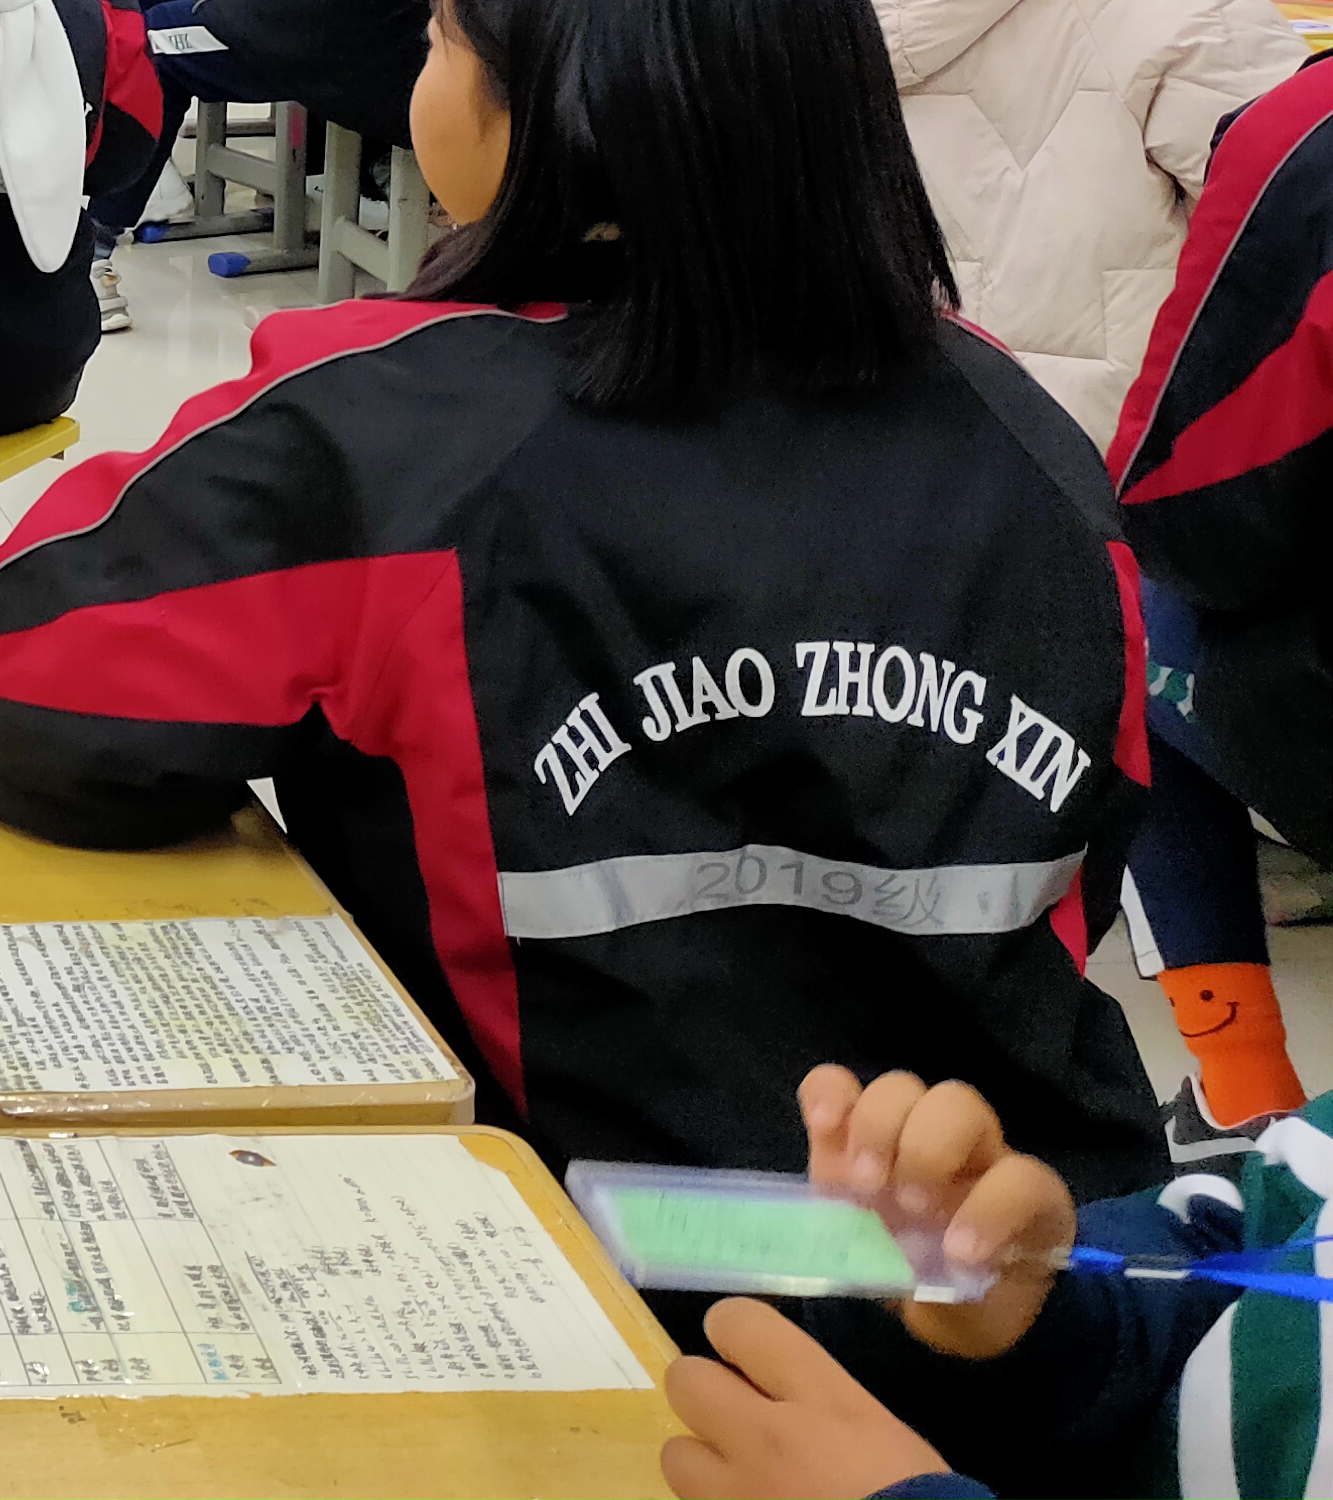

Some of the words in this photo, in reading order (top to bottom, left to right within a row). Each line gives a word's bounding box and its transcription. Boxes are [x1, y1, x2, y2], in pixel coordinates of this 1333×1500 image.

[534, 692, 632, 817] ZHI
[633, 647, 775, 742] JIAO
[795, 640, 988, 745] ZHONG
[986, 694, 1092, 814] XIN
[695, 859, 946, 930] 2019级
